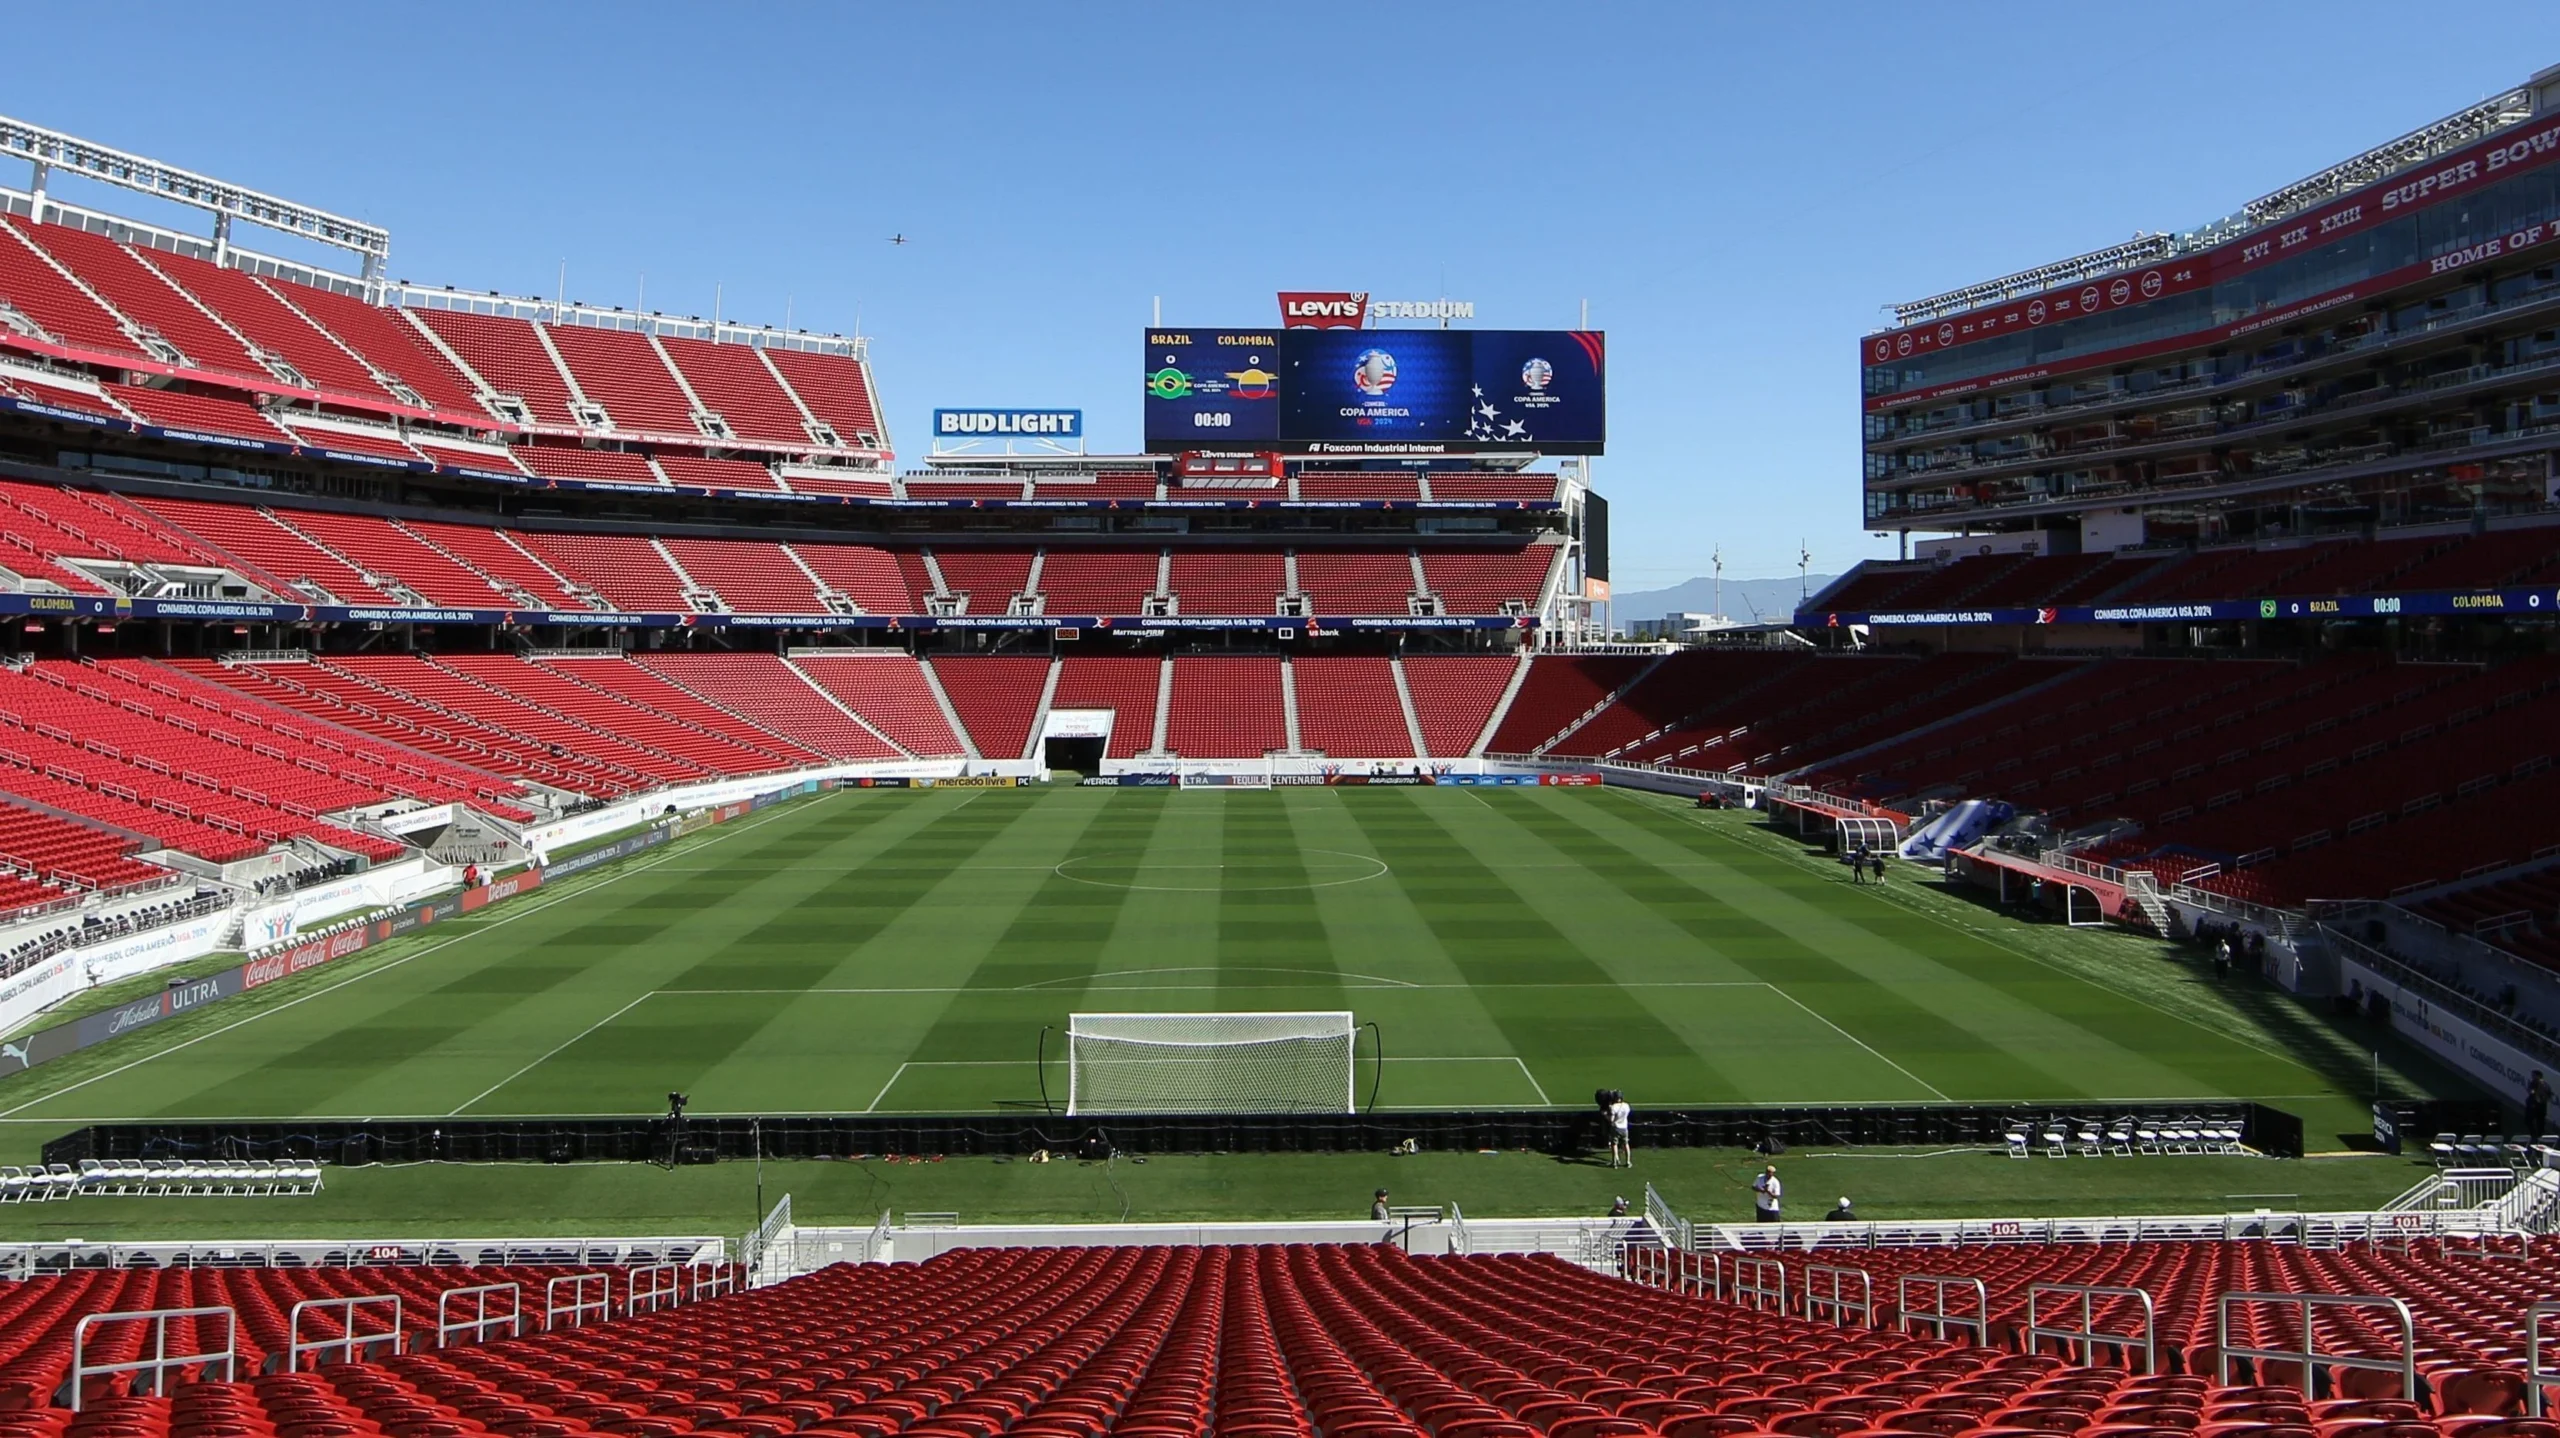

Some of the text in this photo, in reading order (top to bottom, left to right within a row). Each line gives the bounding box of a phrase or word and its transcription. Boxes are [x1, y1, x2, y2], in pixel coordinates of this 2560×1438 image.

[2382, 161, 2478, 210] SUPER
[2244, 206, 2361, 263] XVI XIX XXIII
[2431, 226, 2542, 274] HOME OF
[1374, 302, 1474, 318] STADIUM
[1900, 340, 1910, 348] 12
[1920, 336, 1930, 344] 14
[1941, 330, 1952, 339] 16
[1962, 325, 1974, 333] 21
[1982, 319, 1996, 328] 27
[2004, 314, 2018, 323] 33
[2029, 307, 2043, 317] 34
[2056, 300, 2070, 310] 35
[2082, 294, 2096, 304] 37
[2112, 287, 2128, 297] 39
[2143, 278, 2160, 288] 42
[2173, 271, 2192, 281] 44
[2262, 310, 2299, 326] DIVISION
[2301, 292, 2354, 314] CHAMPIONS
[1151, 335, 1274, 346] BRAZIL COLOMBIA
[1166, 355, 1259, 364] 0 0
[1939, 384, 1977, 396] MORABITO
[1340, 408, 1409, 416] COPA AMERICA
[941, 413, 1074, 432] BUD LIGHT
[1194, 413, 1231, 426] 00:00
[1323, 443, 1444, 452] Foxconn Industrial Internet
[31, 599, 103, 612] COLOMBIA 0
[2291, 601, 2339, 613] 0 BRAZIL
[2374, 598, 2400, 612] 00:00
[2453, 595, 2539, 607] COLOMBIA 0
[157, 604, 273, 616] CONMEBOL COPA AMERICA USA 2024
[349, 610, 390, 619] CONMEBOL
[392, 611, 410, 619] COPA
[410, 611, 442, 620] AMERICA
[444, 612, 457, 620] USA
[2094, 606, 2211, 619] CONMEBOL COPA AMERICA USA 2024
[731, 617, 771, 625] CONMEBOL
[772, 617, 792, 625] COPA
[1870, 612, 1992, 623] CONMEBOL COPA AMERICA USA 2024
[939, 777, 1006, 786] mercado livre
[1084, 777, 1118, 785] WERADE
[1232, 775, 1324, 784] TEQUILA CENTENARIO
[488, 880, 518, 902] Betano
[434, 904, 454, 918] priceless
[393, 917, 414, 931] priceless
[125, 944, 144, 959] COPA
[147, 936, 176, 954] AMERICA
[177, 932, 192, 942] USA
[192, 928, 207, 938] 2024
[19, 980, 32, 996] COPA
[33, 969, 53, 988] AMERICA
[54, 964, 64, 976] USA
[109, 980, 218, 1034] Michelob ULTRA
[2470, 1045, 2526, 1087] CONMEBOL COPA
[2396, 1217, 2418, 1227] 101
[1995, 1224, 2017, 1235] 102
[374, 1248, 398, 1258] 104
